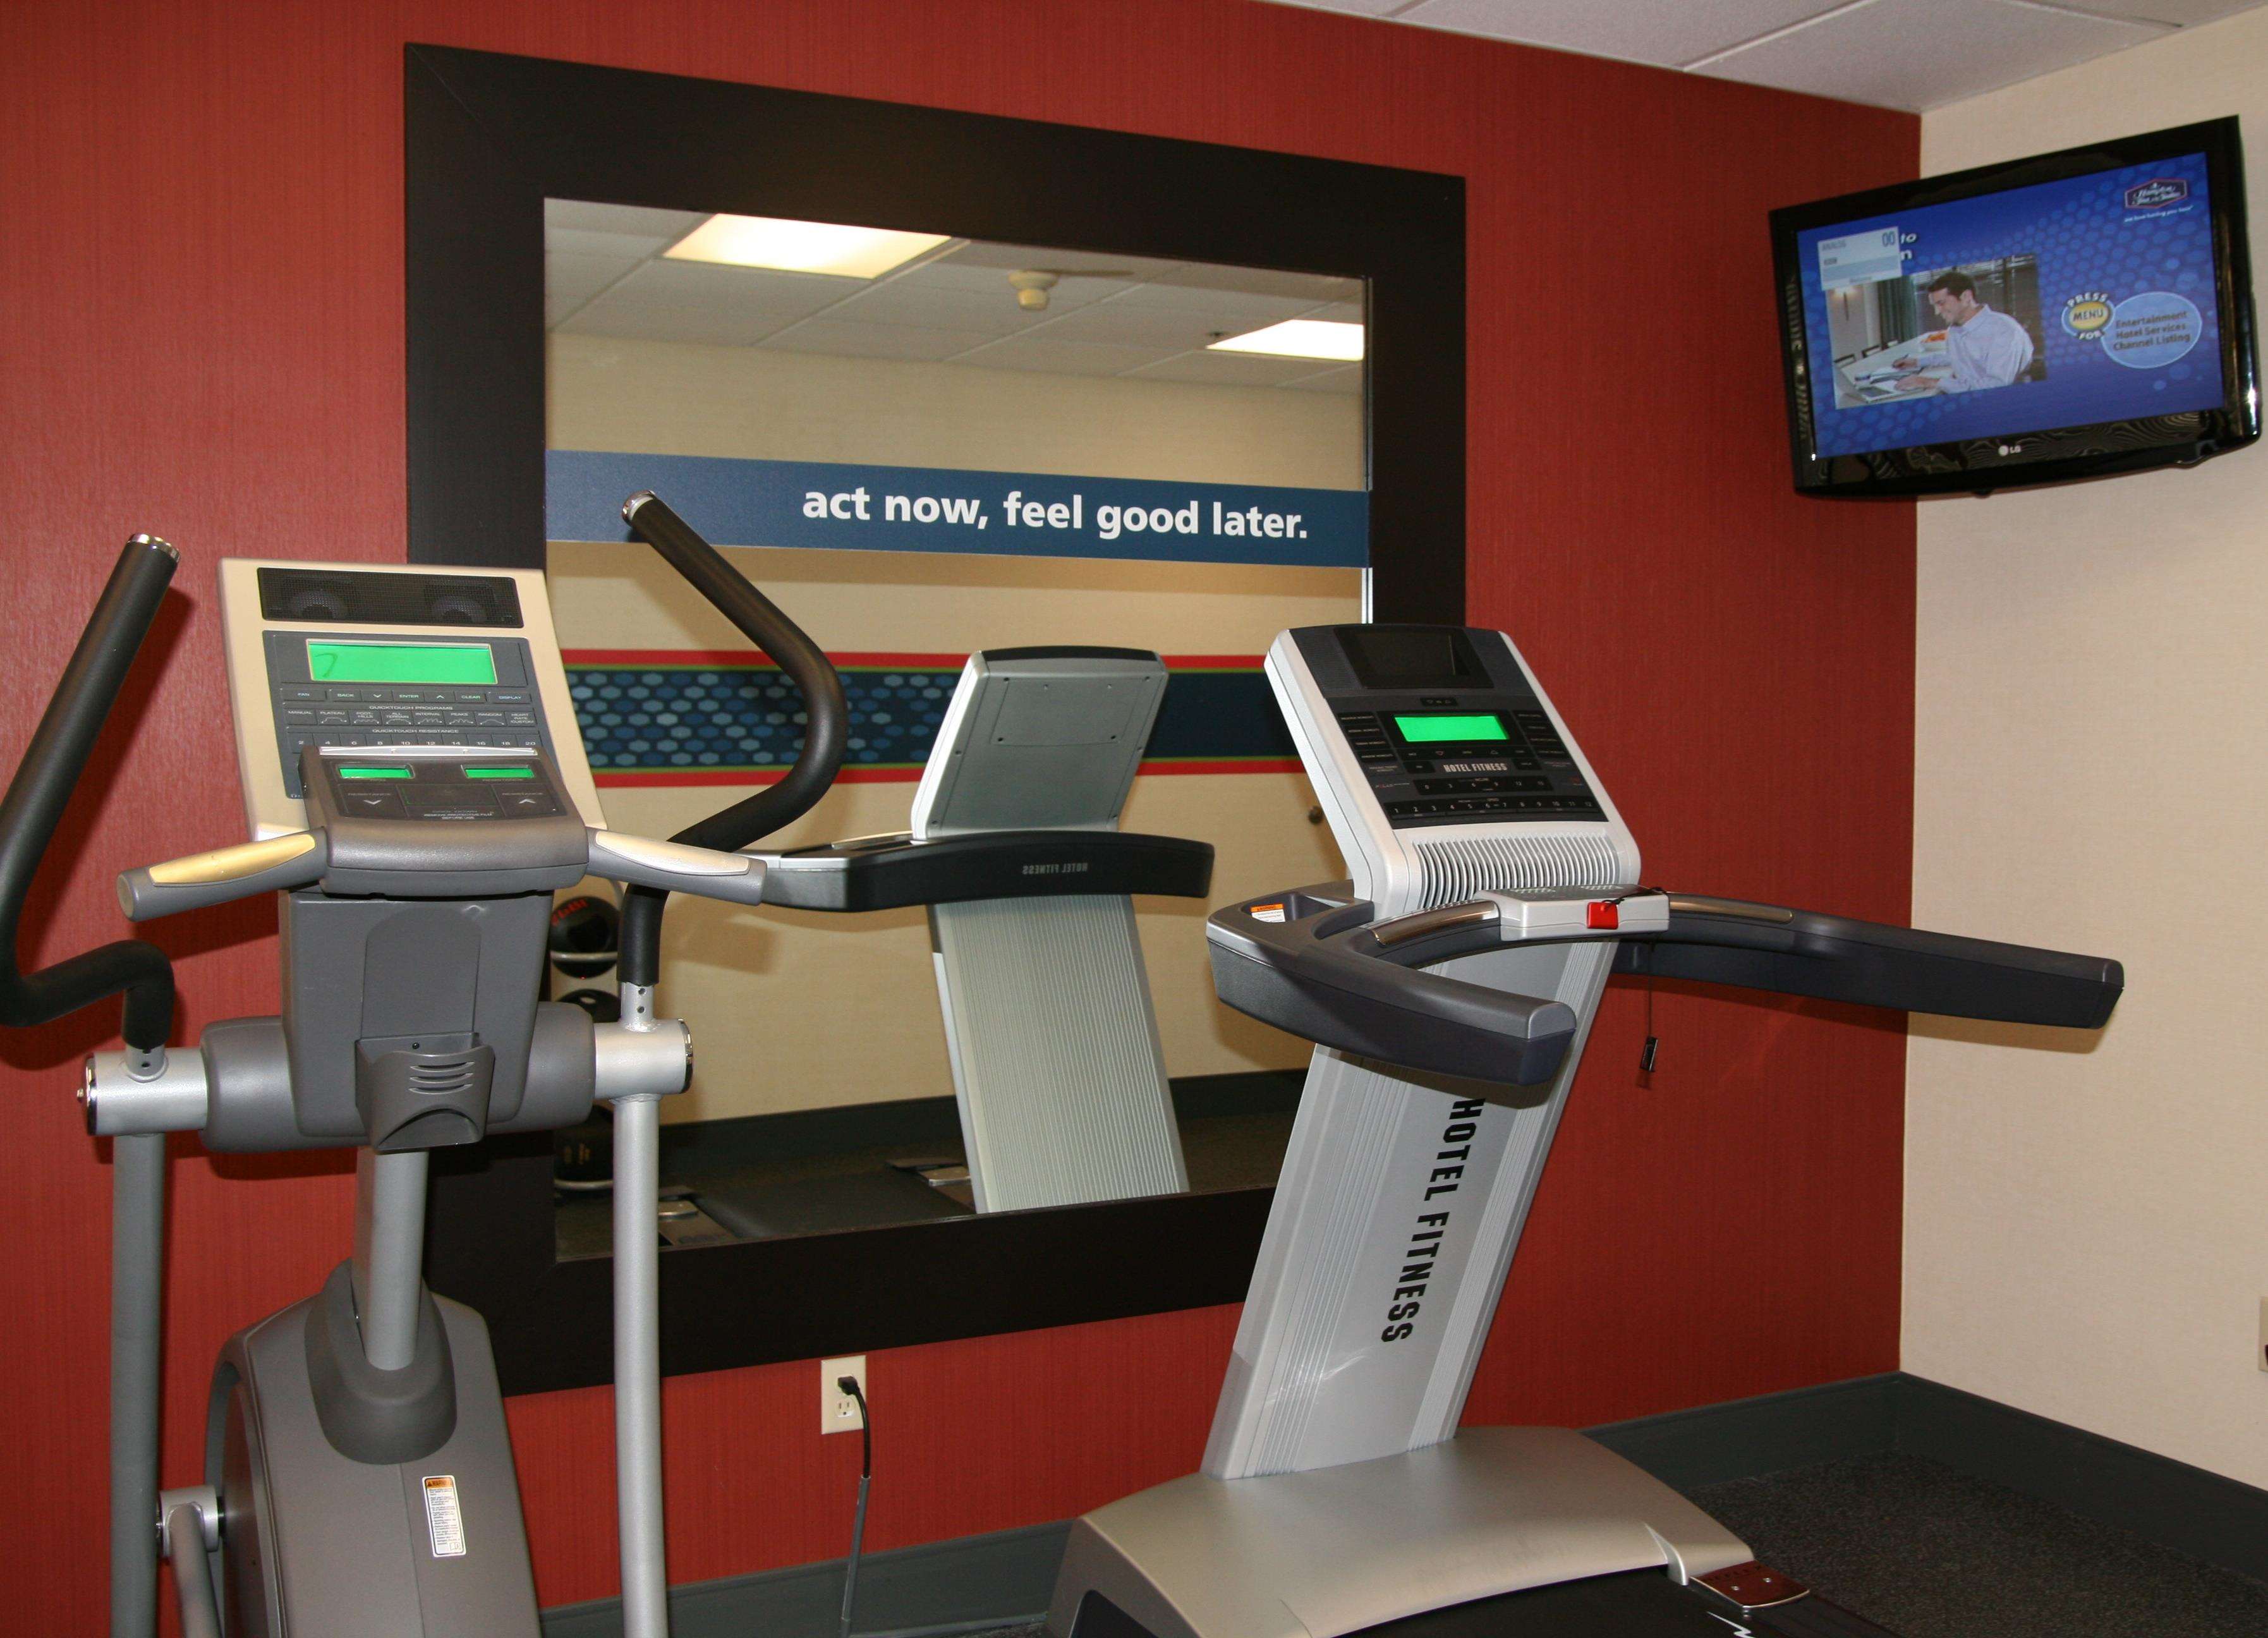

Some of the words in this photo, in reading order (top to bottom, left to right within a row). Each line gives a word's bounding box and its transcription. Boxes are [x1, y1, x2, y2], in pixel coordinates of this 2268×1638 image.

[2067, 291, 2109, 308] PRESS
[2073, 309, 2104, 322] MENU
[2116, 310, 2188, 328] Entertainment
[2079, 329, 2102, 340] FOR
[2116, 329, 2143, 339] Hotel
[2145, 323, 2186, 335] Services
[2113, 338, 2154, 350] Channel
[2156, 333, 2192, 344] Listing
[803, 487, 870, 519] act
[886, 496, 988, 529] now,
[1004, 491, 1081, 528] feel
[1097, 500, 1198, 539] good
[1214, 502, 1306, 538] later.
[1443, 763, 1472, 773] HOTEL
[1472, 762, 1508, 772] FITNESS
[1424, 1098, 1486, 1201] HOTEL
[1381, 1211, 1450, 1342] FITNESS
